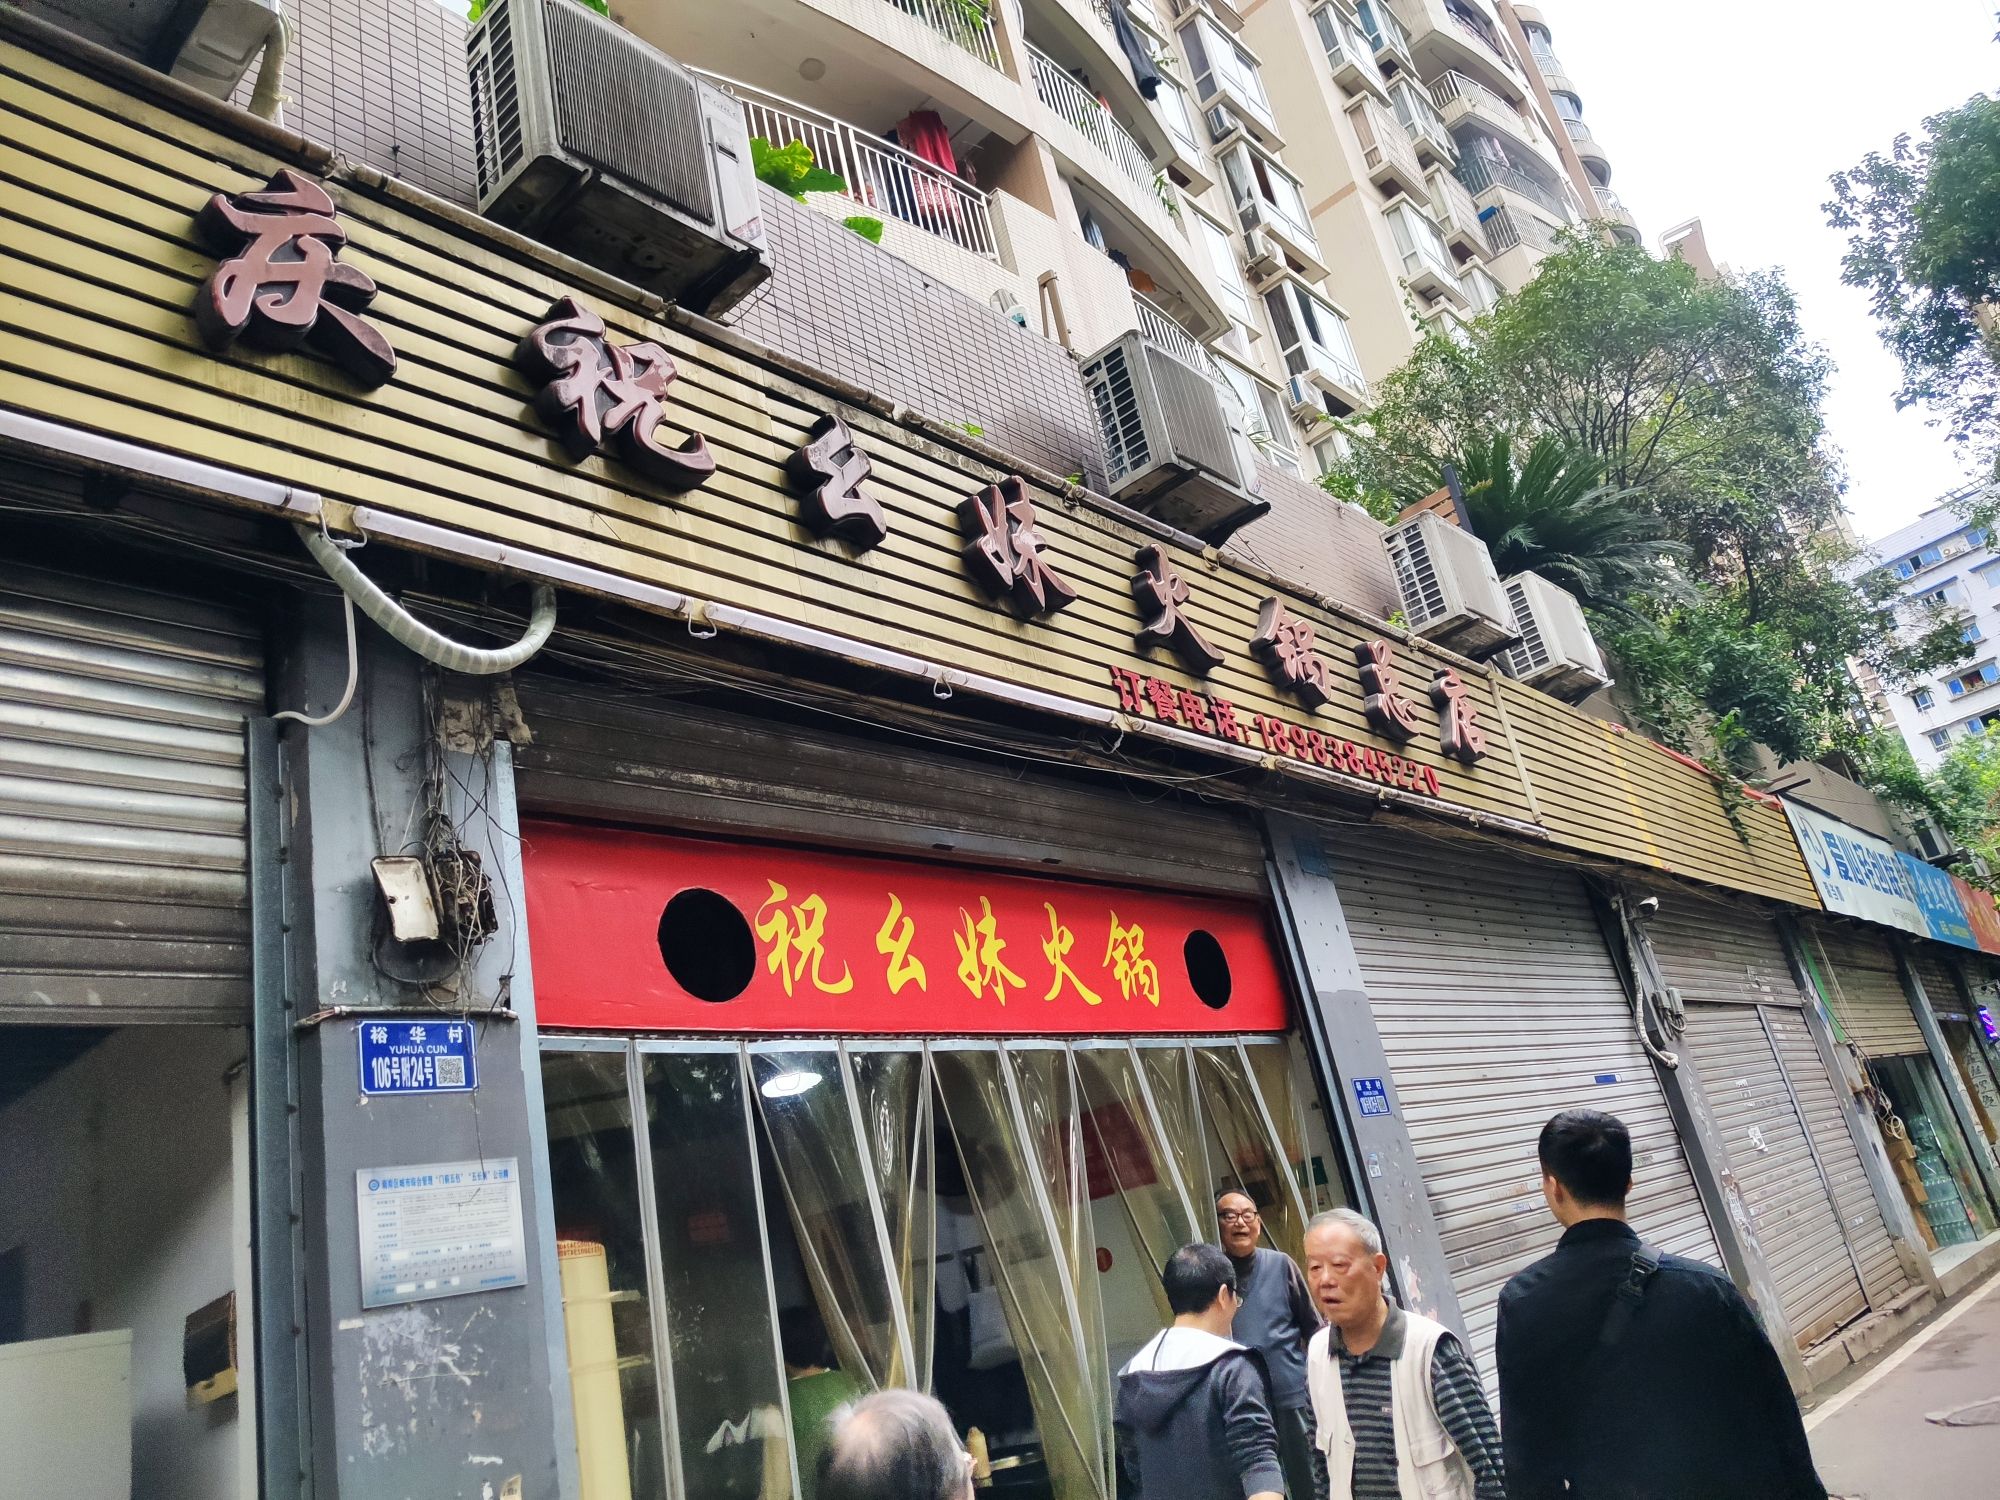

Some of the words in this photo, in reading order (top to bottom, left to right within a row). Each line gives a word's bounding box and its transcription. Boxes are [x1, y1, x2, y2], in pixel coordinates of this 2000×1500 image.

[754, 878, 1160, 1007] 祝幺妹火锅
[370, 1026, 464, 1044] 裕华村
[389, 1045, 424, 1055] YUHUA
[426, 1044, 448, 1054] CUN
[371, 1056, 434, 1088] 106号附24号
